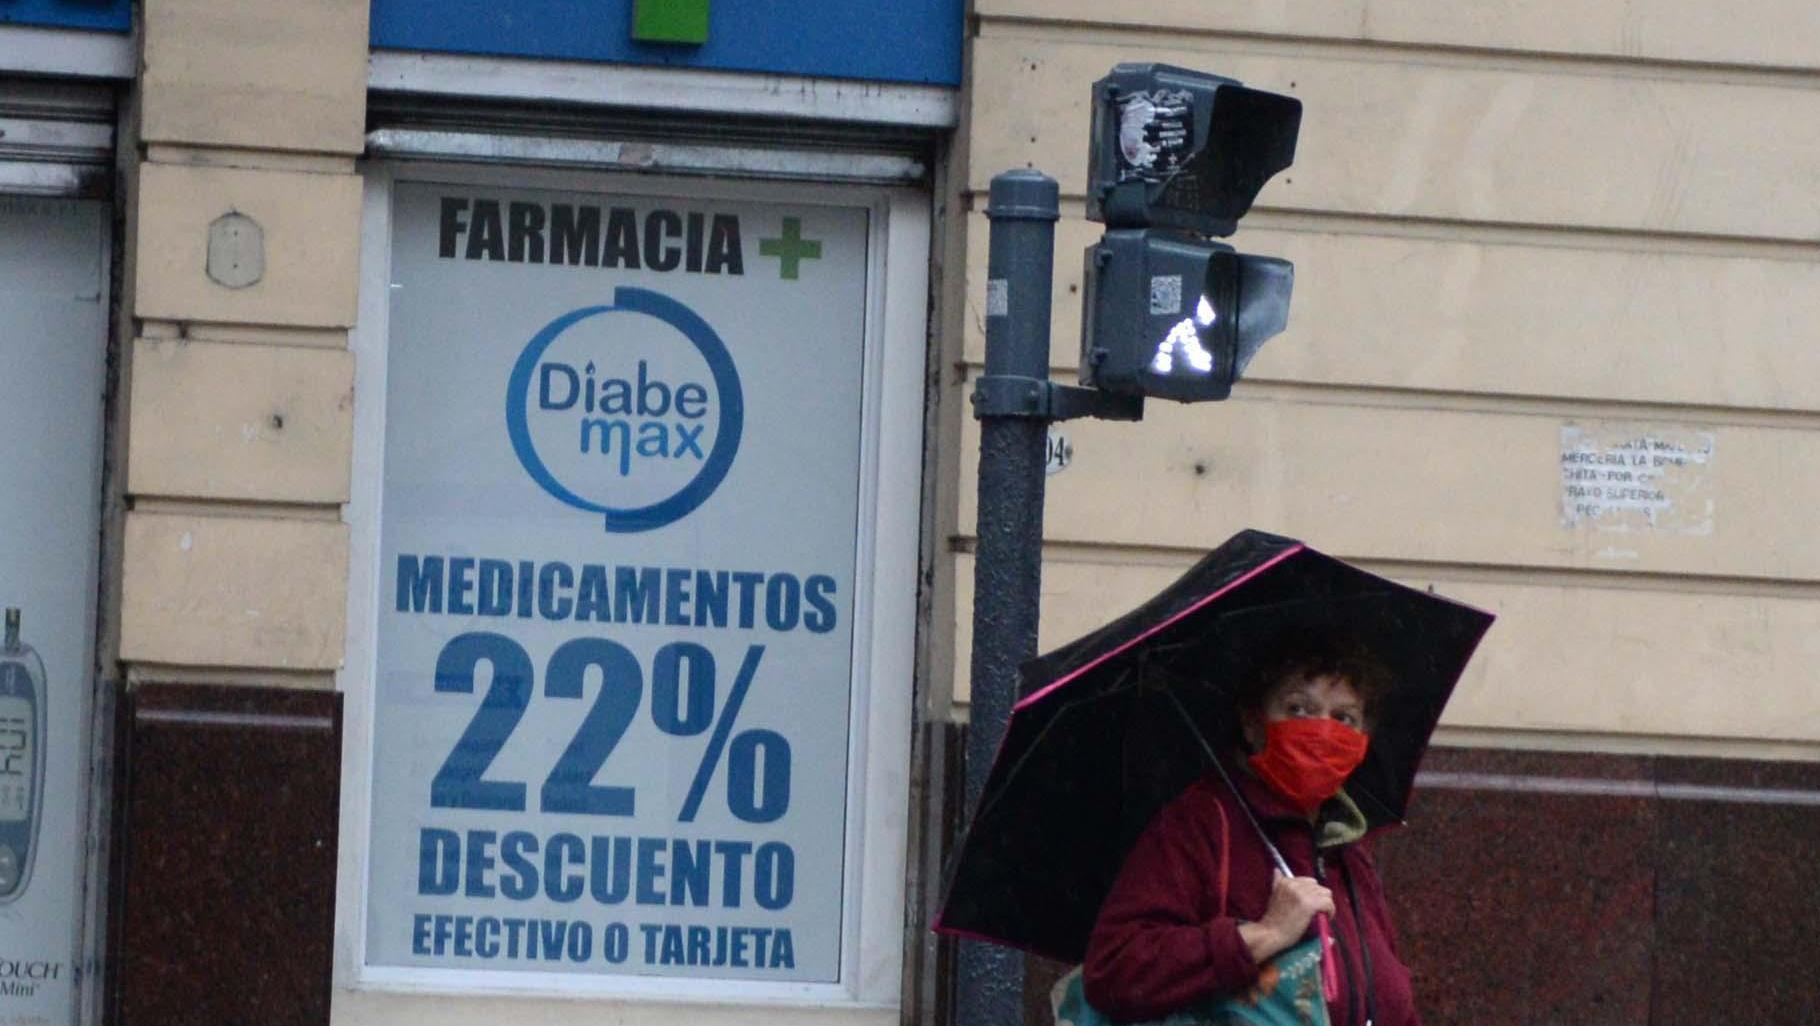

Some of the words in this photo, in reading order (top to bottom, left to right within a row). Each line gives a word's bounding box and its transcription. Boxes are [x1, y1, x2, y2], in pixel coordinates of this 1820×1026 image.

[439, 196, 744, 275] FARMACIA
[540, 360, 707, 419] Diabe
[580, 417, 704, 476] max
[396, 554, 837, 633] MEDICAMENTOS
[430, 631, 792, 823] 22%
[418, 827, 795, 910] DESCUENTO
[412, 914, 593, 963] EFECTIVO
[604, 922, 629, 964] O
[640, 923, 795, 969] TARJETA
